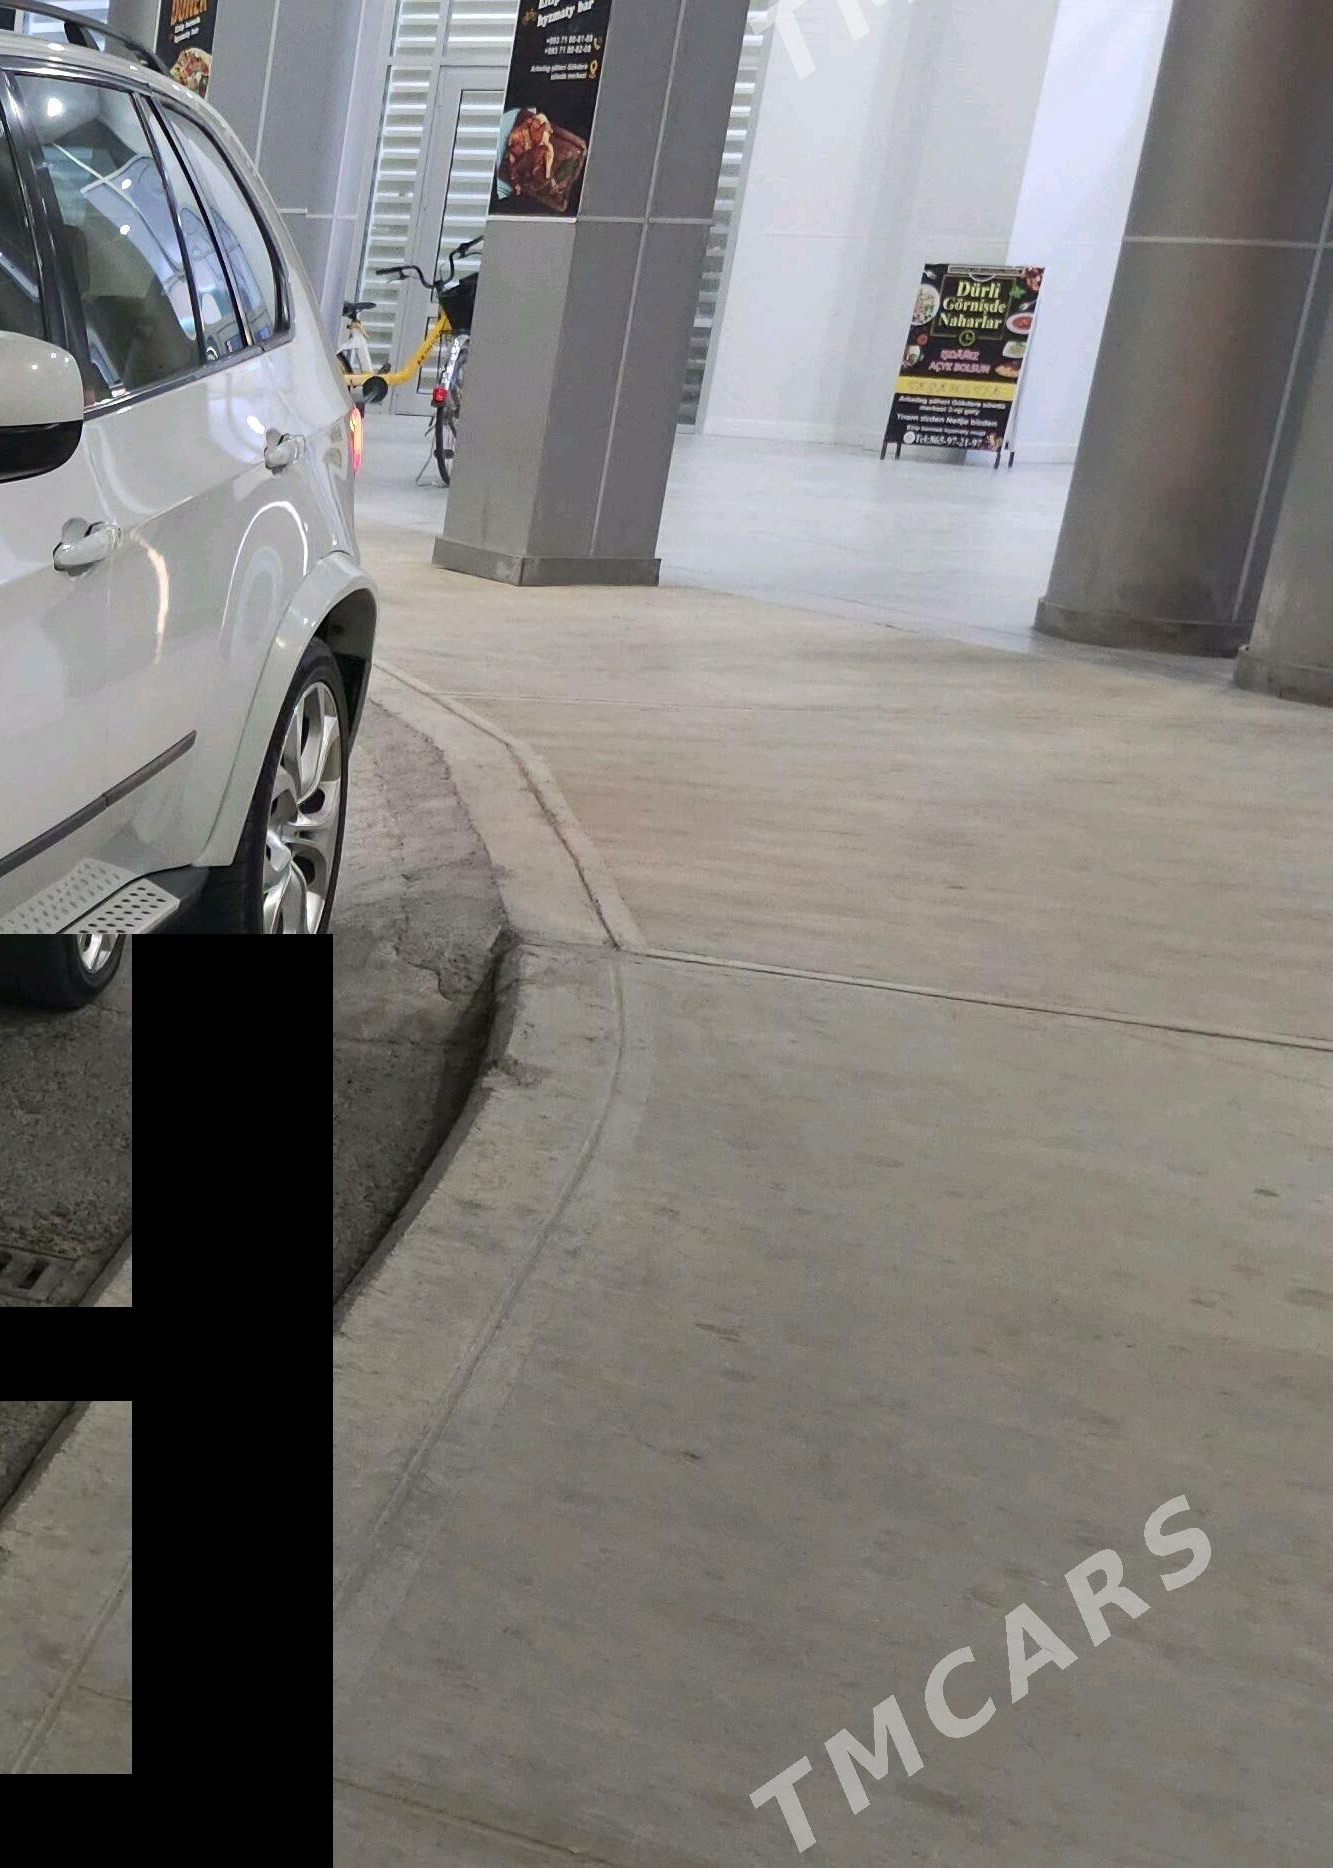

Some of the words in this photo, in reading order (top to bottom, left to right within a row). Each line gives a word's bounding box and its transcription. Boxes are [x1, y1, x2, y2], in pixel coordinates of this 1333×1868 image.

[957, 281, 1001, 298] Dürli
[943, 297, 1006, 312] Görnişde
[939, 312, 1002, 329] Naharlar
